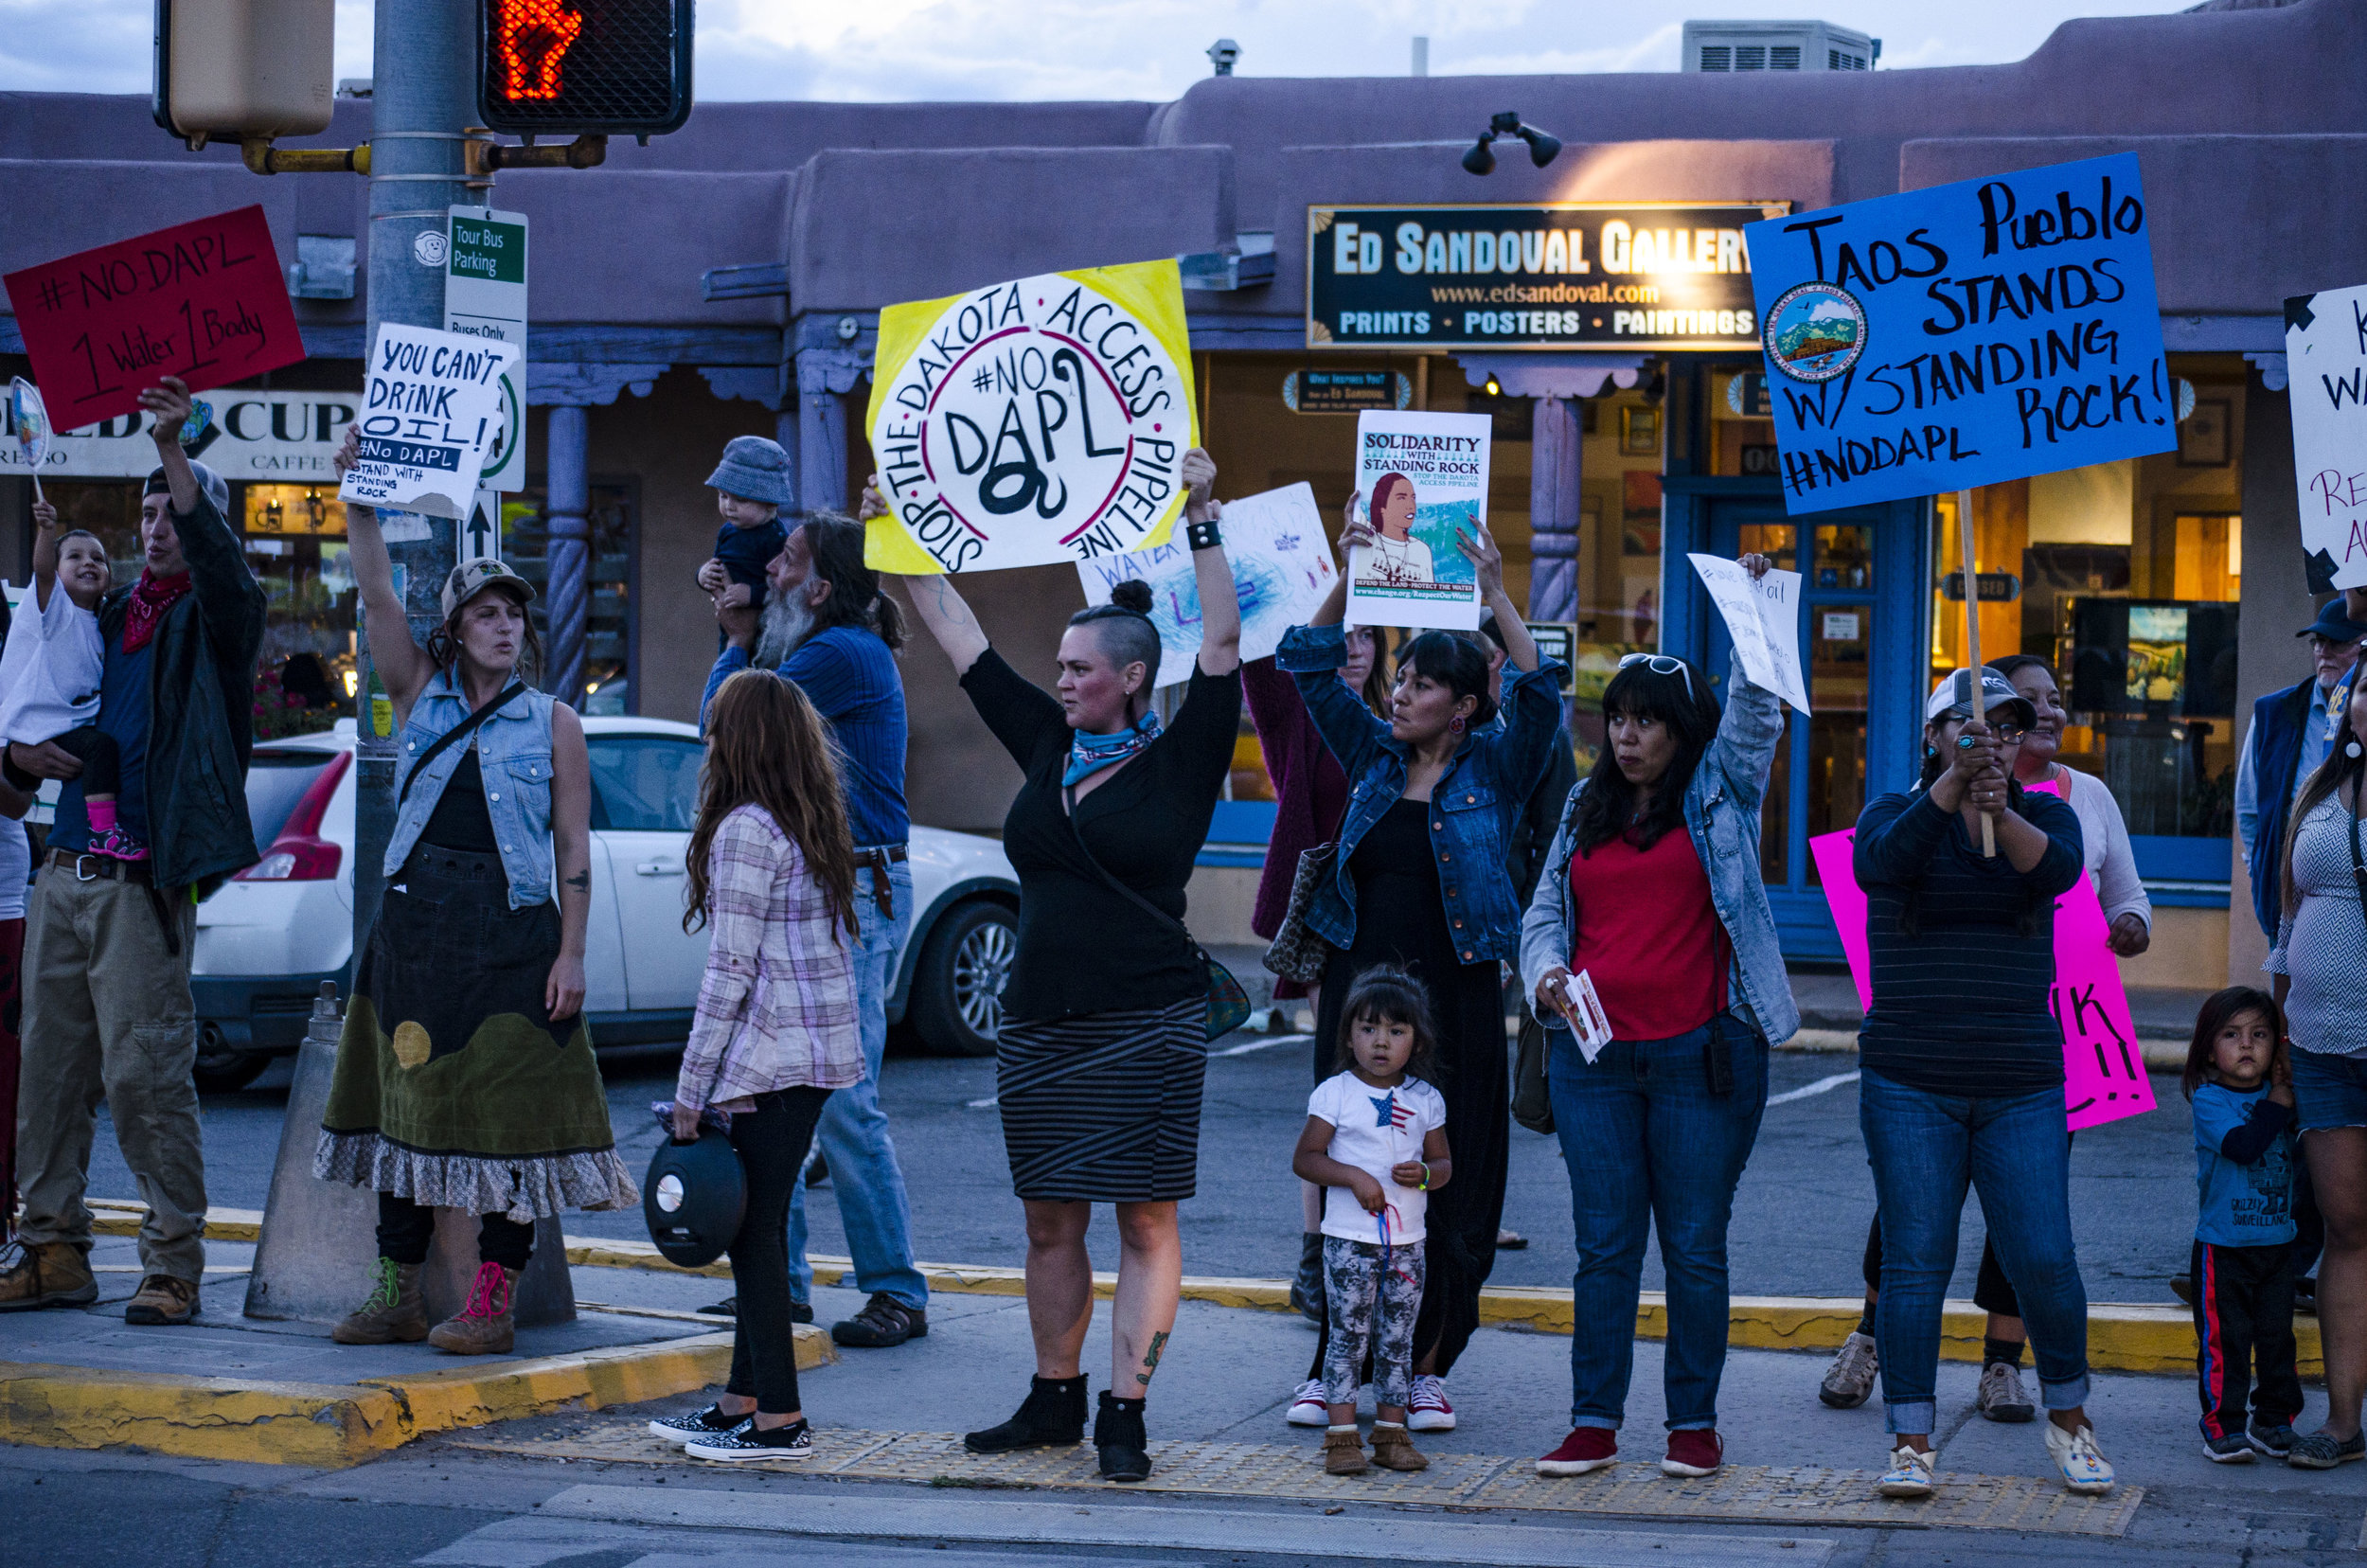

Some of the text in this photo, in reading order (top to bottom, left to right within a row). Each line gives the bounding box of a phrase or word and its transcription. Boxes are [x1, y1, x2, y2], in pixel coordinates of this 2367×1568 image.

[455, 225, 504, 248] Tour Bus
[1783, 176, 2144, 291] TAOS Pueblo
[454, 250, 497, 277] Parking
[1432, 281, 1660, 303] www.edsandoval.com
[1923, 258, 2124, 335] STANDS
[1340, 310, 1753, 334] PRINTS POSTERS PAINTINGS
[72, 298, 266, 403] 1 Water 1 Body
[383, 339, 503, 385] YOU CAN'T
[972, 347, 1046, 396] #NO
[2016, 358, 2165, 448] ROCK!
[224, 401, 354, 442] CUP
[883, 282, 1176, 573] STOP THE DAKOTA ACCESS PIPELINE
[945, 347, 1125, 519] DAPL
[364, 416, 488, 452] OIL!
[1365, 434, 1481, 452] SOLIDARITY
[252, 455, 326, 472] CAFFE
[400, 447, 453, 467] DAPL
[1364, 459, 1480, 474] STANDING ROCK
[1407, 451, 1435, 460] WITH
[347, 474, 397, 490] STANDING
[351, 464, 423, 482] STAND WITH
[357, 486, 387, 498] ROCK
[1767, 581, 1786, 604] oil
[2231, 1198, 2265, 1213] GRIZZLY
[2233, 1213, 2291, 1228] SURVEILLANC
